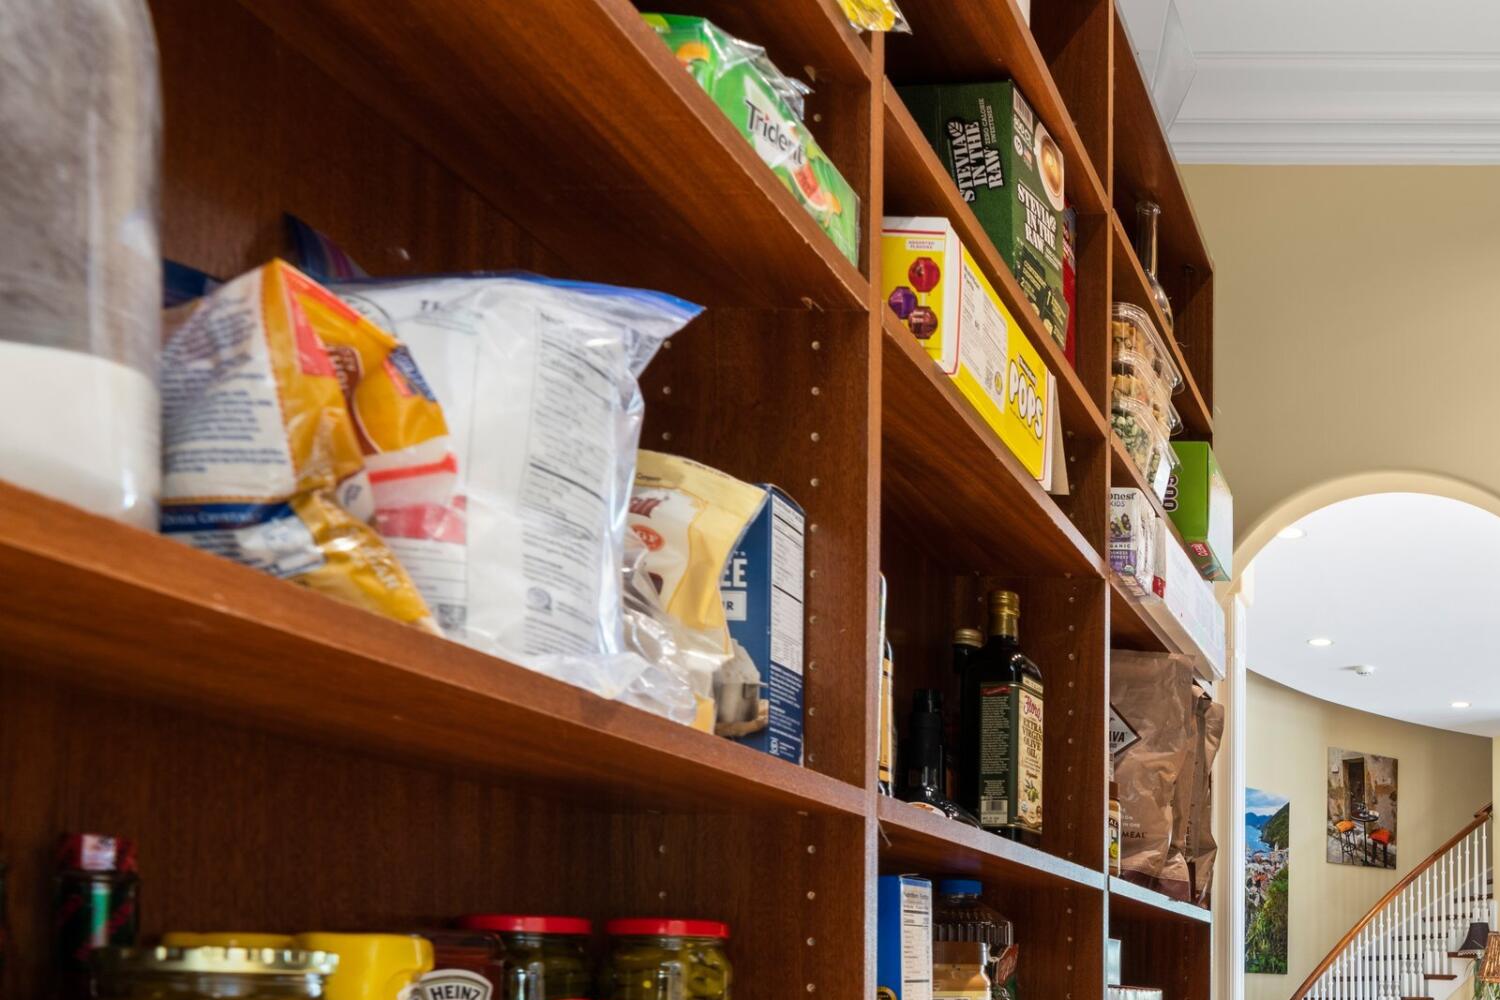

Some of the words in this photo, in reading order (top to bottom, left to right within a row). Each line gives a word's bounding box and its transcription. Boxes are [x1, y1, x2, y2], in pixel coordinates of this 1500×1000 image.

[745, 99, 804, 165] Trident
[964, 121, 984, 164] THE
[953, 137, 976, 202] STEVIA
[971, 163, 989, 188] IN
[984, 147, 1004, 189] RAW
[1017, 183, 1056, 232] STEVIA
[1009, 359, 1043, 440] POPS
[1110, 491, 1137, 501] nest
